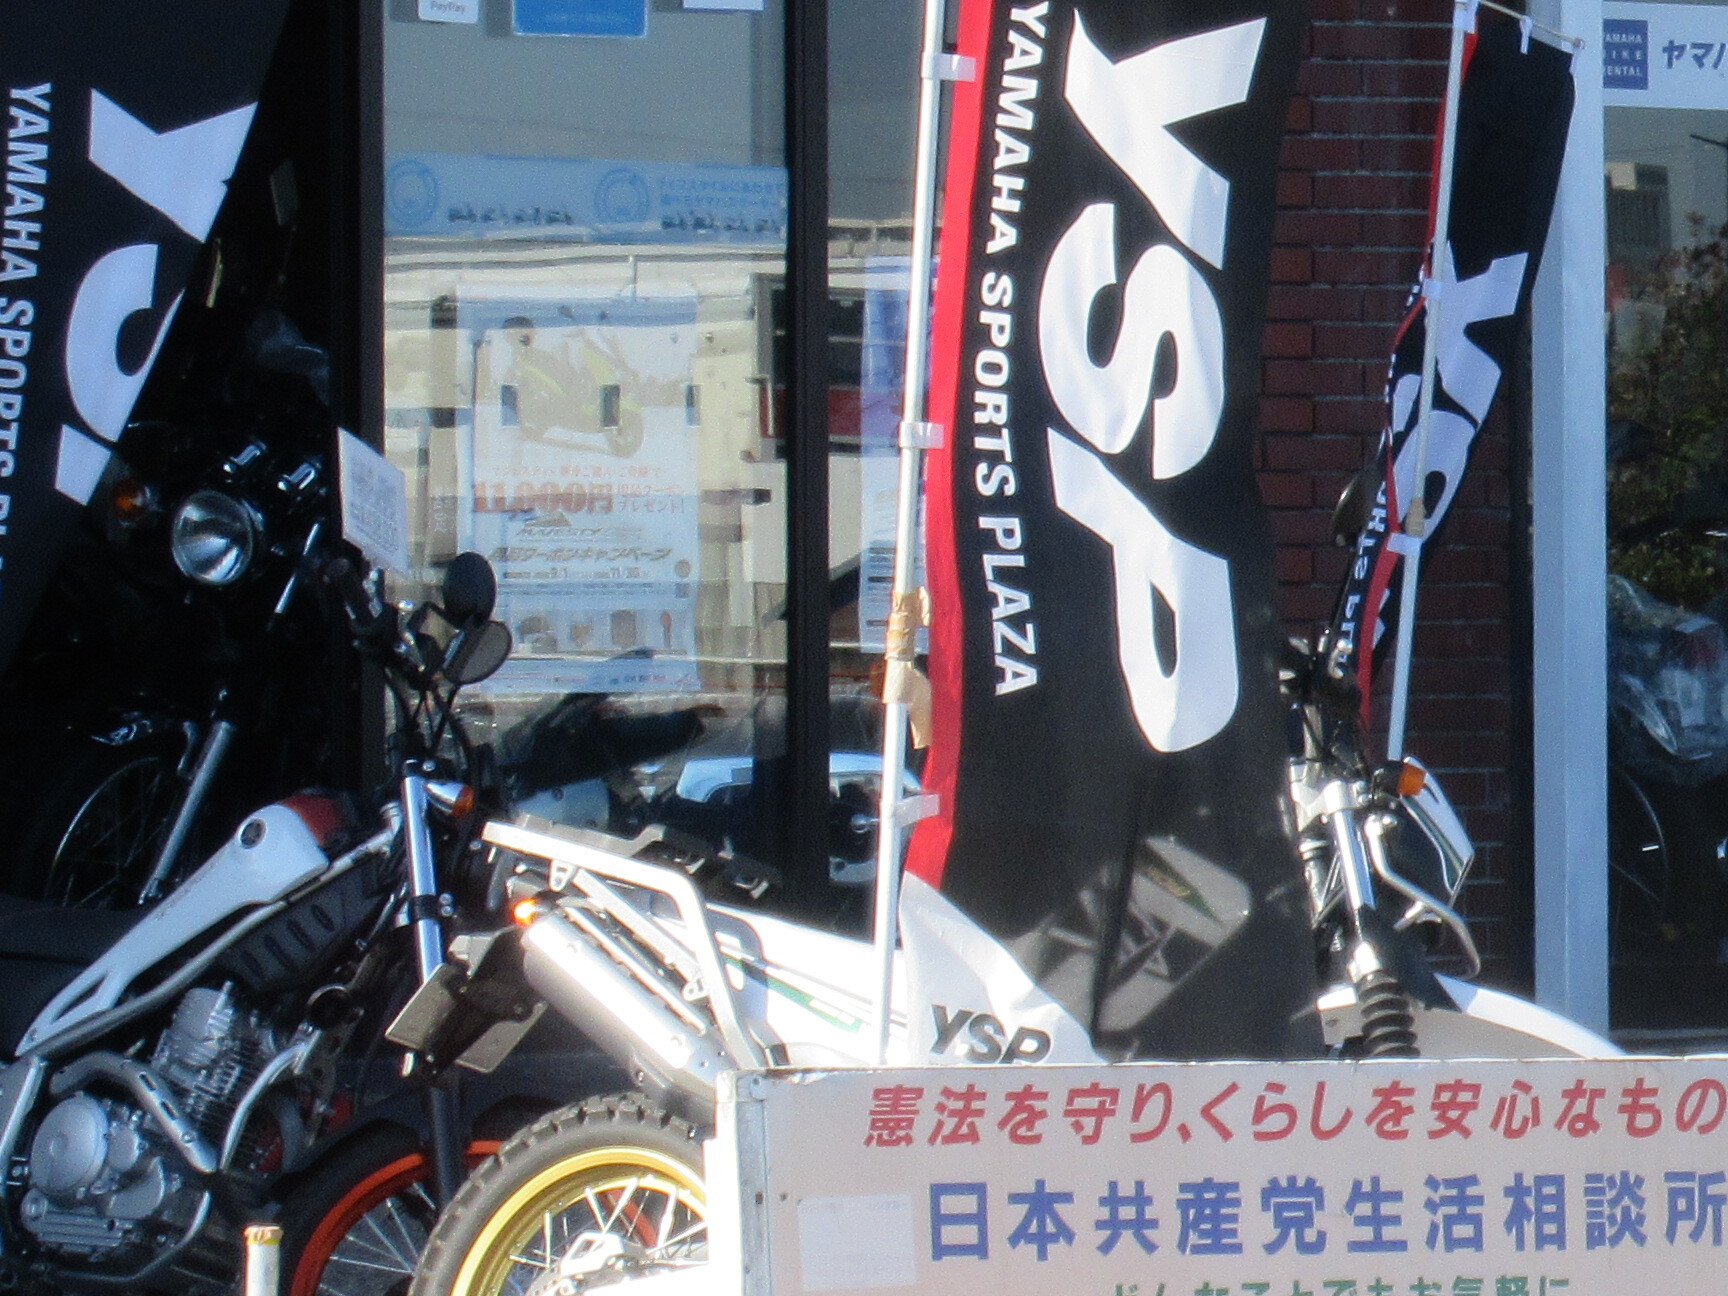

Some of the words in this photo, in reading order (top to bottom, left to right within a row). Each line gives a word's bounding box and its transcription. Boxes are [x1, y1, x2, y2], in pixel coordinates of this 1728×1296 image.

[1604, 33, 1643, 45] AMAHA
[0, 82, 52, 284] YAMAHA
[970, 271, 1019, 513] SPORTS
[1038, 6, 1267, 754] YSP
[977, 516, 1038, 698] PLAZA
[930, 1003, 1051, 1065] YSP
[928, 1170, 1728, 1262] 日本共産党生活相談所
